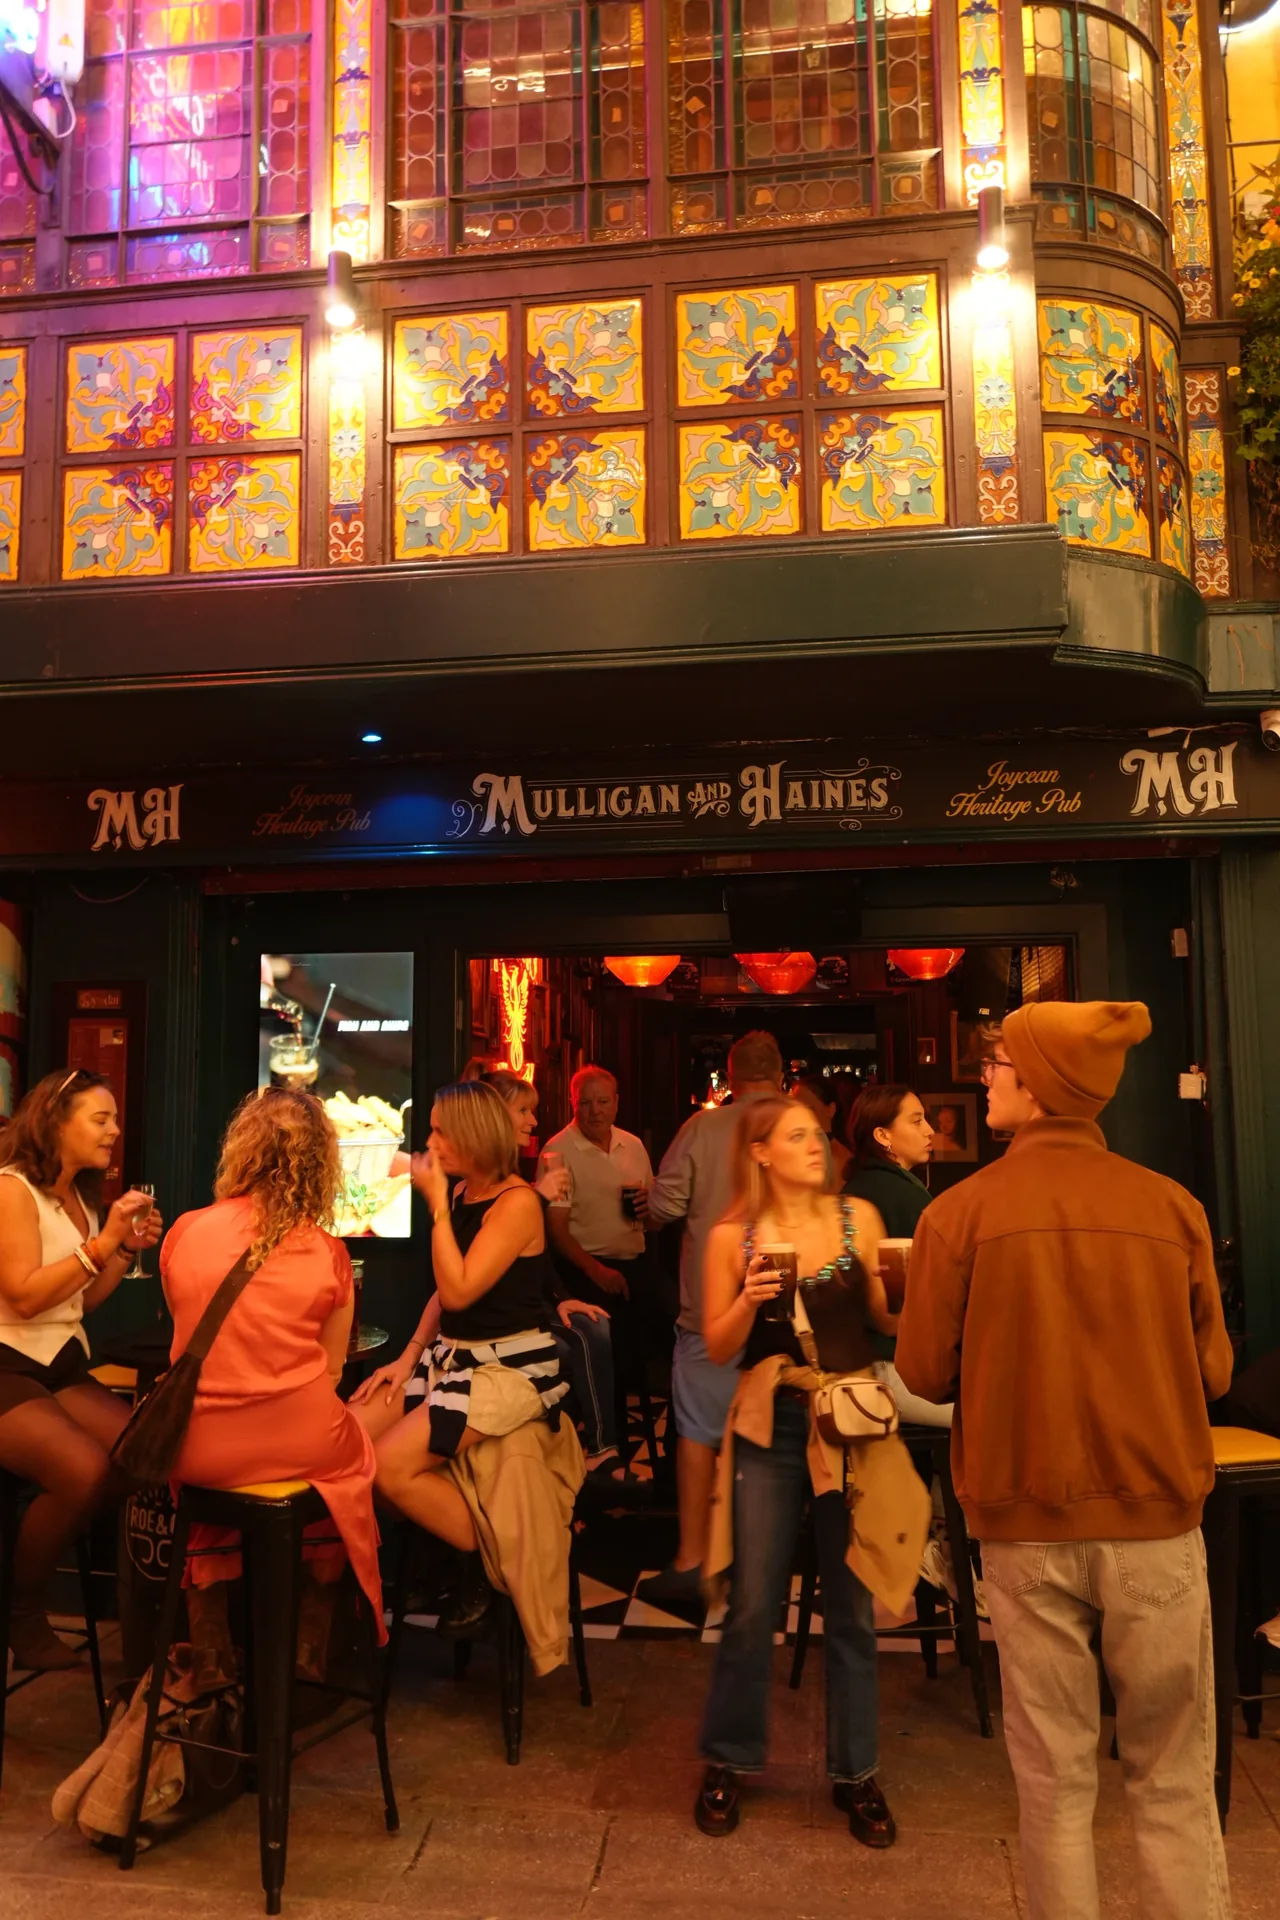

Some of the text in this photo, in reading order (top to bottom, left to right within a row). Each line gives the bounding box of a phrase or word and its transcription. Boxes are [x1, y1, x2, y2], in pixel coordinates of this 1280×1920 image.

[977, 760, 1061, 791] Joycean
[280, 784, 354, 812] Joycean
[470, 759, 889, 837] MULLIGAN AND HAINES
[945, 788, 1082, 821] Heritage Pub
[251, 808, 371, 840] Heritage Pub
